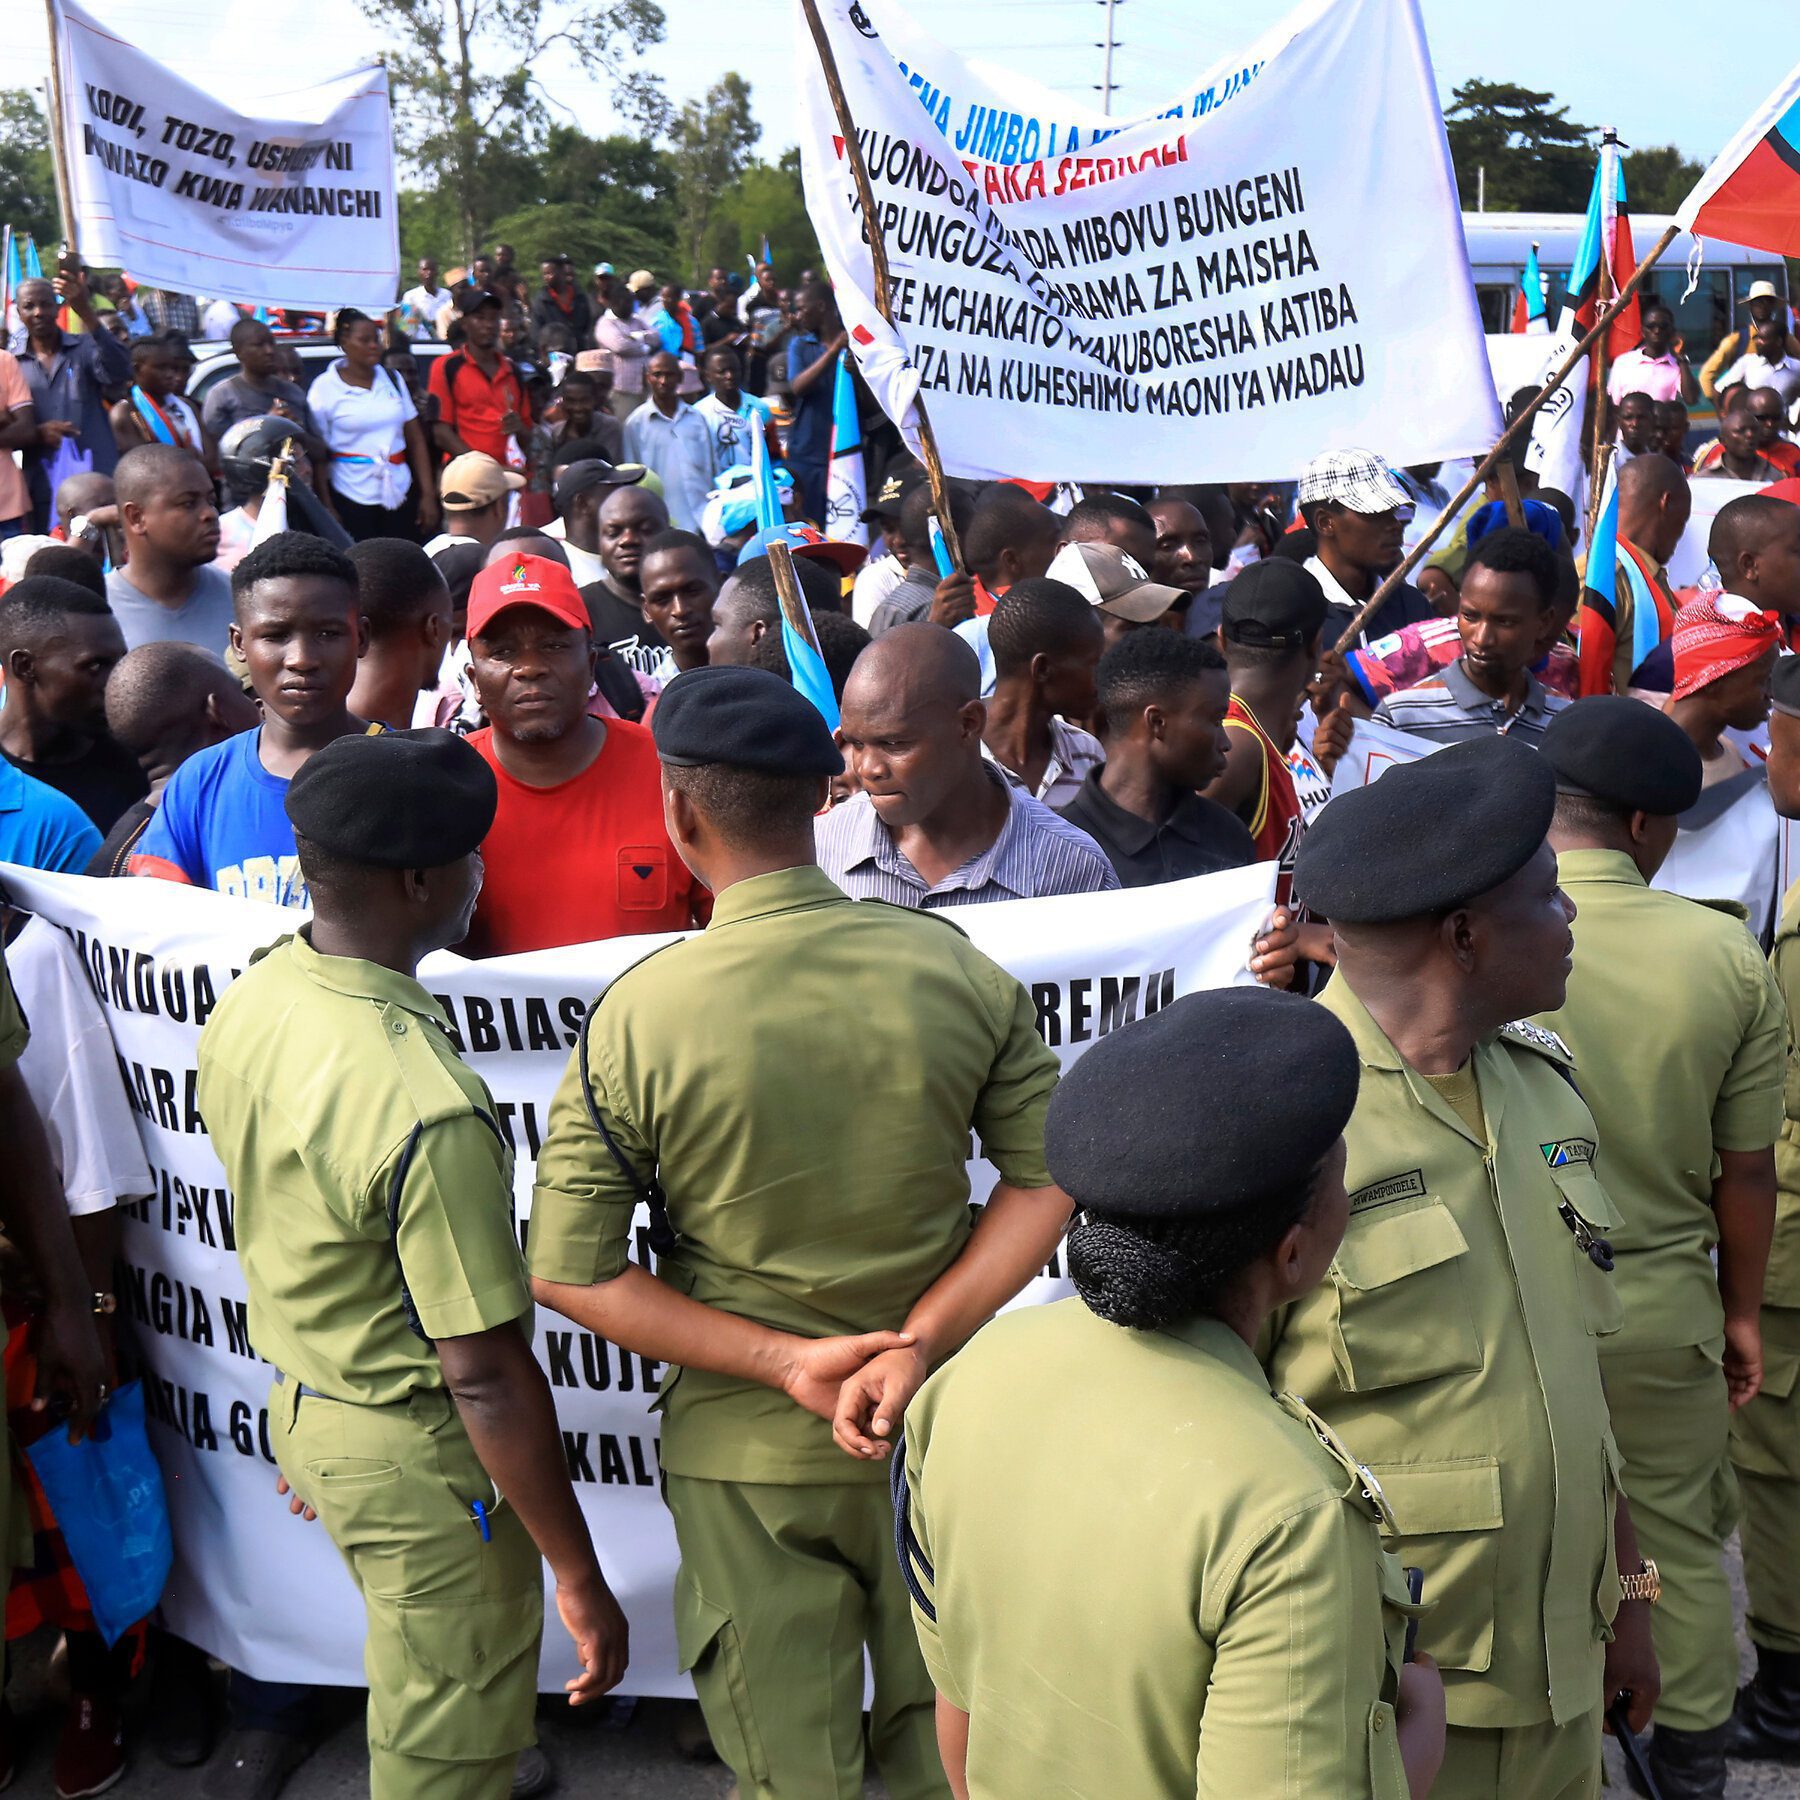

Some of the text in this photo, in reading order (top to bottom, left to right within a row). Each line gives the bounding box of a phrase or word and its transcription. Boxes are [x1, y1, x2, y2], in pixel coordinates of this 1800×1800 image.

[161, 115, 237, 169] TOZO,
[326, 141, 354, 171] NI
[955, 104, 1041, 167] JIMBO
[175, 170, 245, 211] KWA
[248, 185, 382, 219] WANANCHI
[1062, 200, 1170, 268] MIBOVU
[1173, 166, 1305, 243] BUNGENI
[1147, 261, 1193, 310] ZA
[1196, 229, 1320, 299] MAISHA
[919, 281, 1064, 349] MCHAKATO
[1260, 283, 1359, 347] KATIBA
[956, 351, 992, 398] NA
[1000, 358, 1140, 414] KUHESHIMU
[1267, 343, 1366, 404] WADAU
